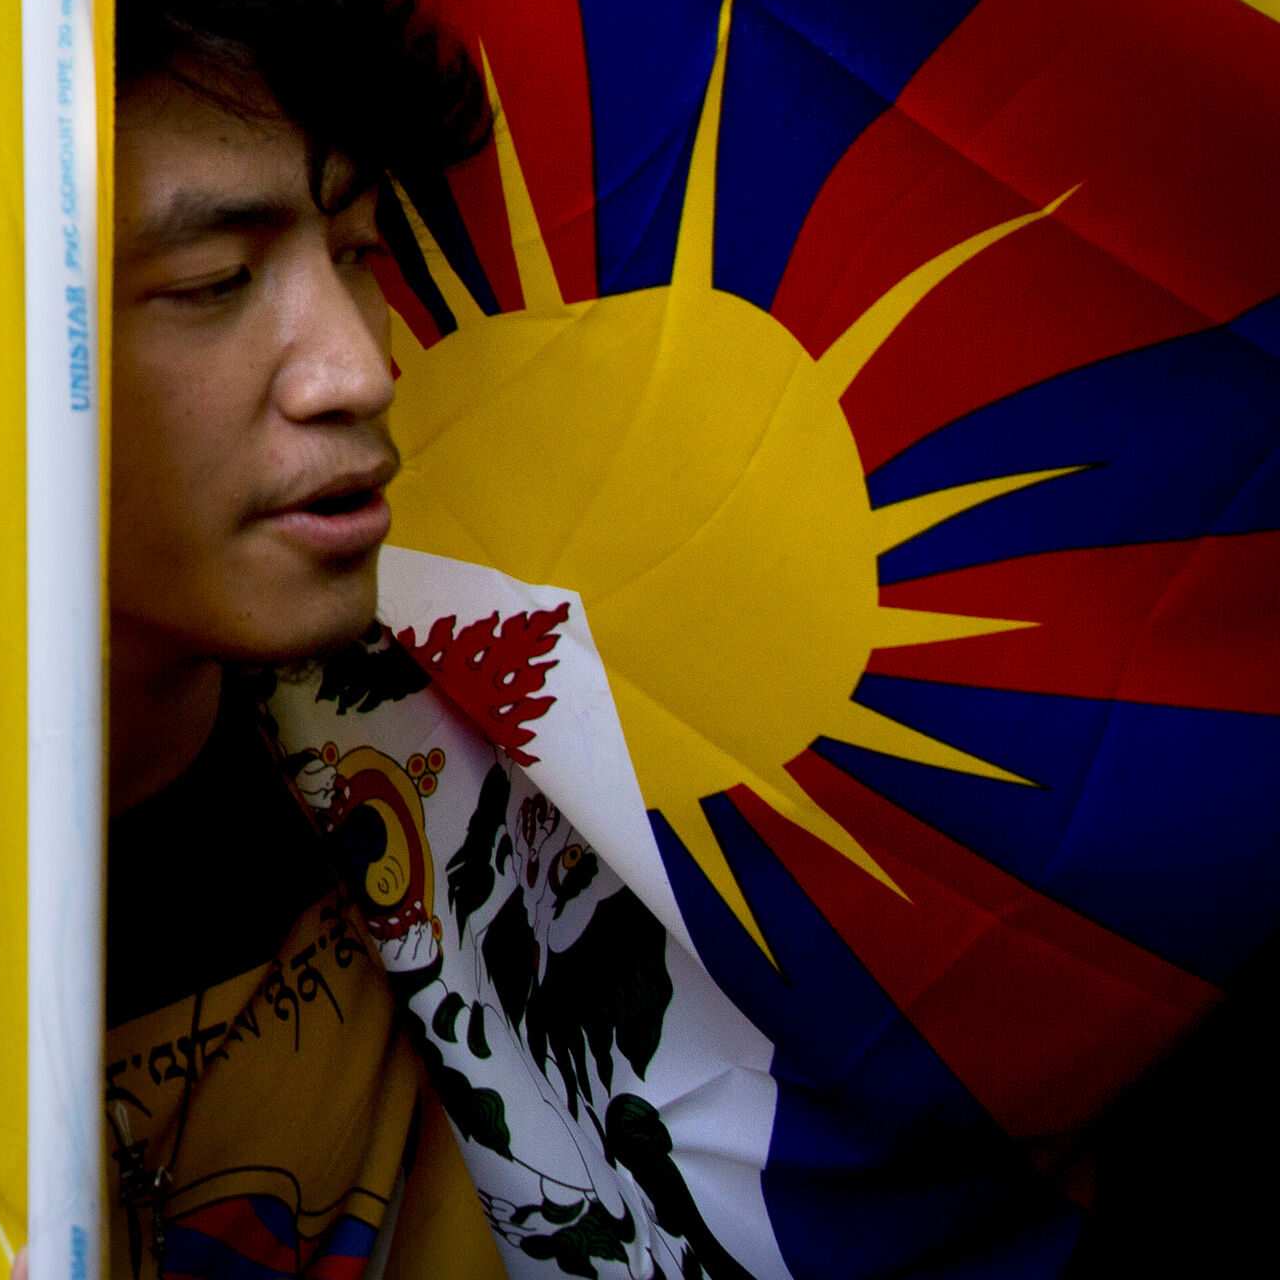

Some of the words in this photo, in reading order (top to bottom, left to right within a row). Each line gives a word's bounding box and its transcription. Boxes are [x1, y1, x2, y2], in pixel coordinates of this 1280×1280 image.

[58, 58, 74, 106] PIPE
[59, 117, 78, 214] CONDUIT
[61, 223, 81, 269] PVC
[66, 286, 91, 412] UNISTAR
